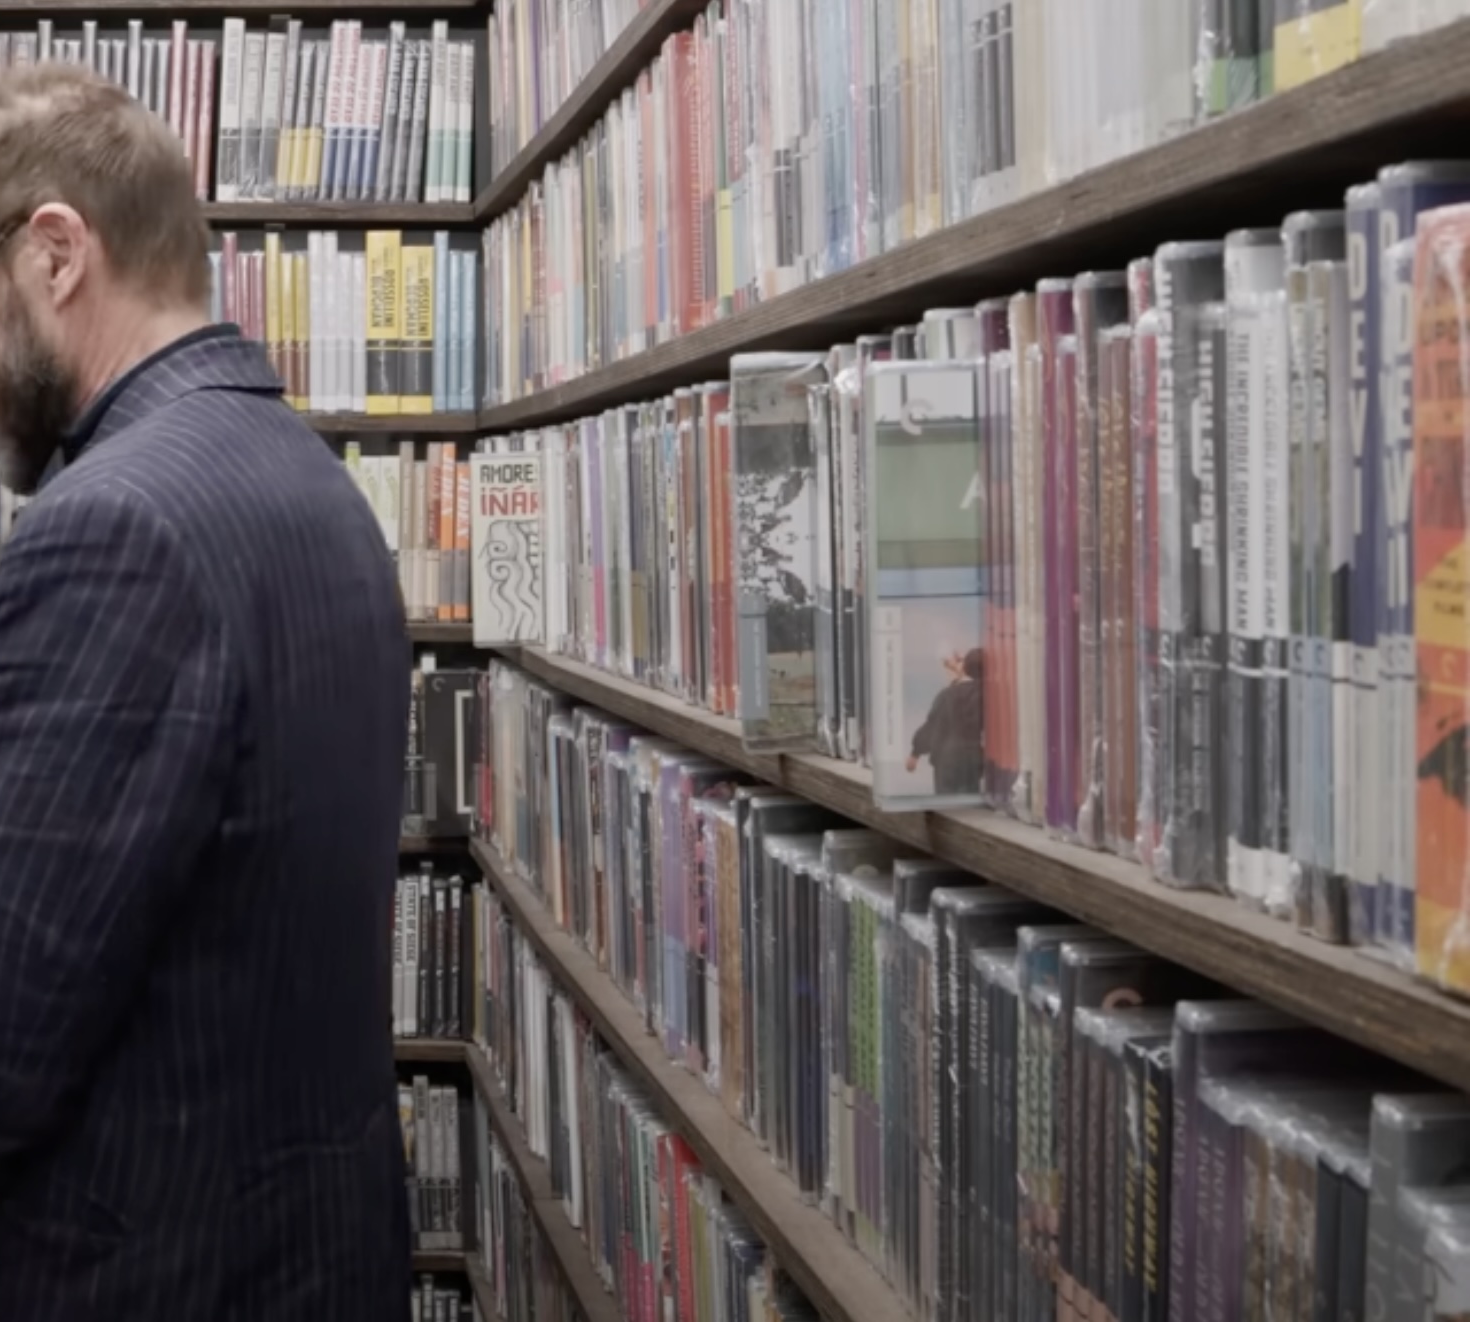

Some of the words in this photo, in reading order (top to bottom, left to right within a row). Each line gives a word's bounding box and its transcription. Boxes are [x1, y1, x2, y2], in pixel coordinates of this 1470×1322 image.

[1197, 340, 1215, 428] HIGH
[1235, 332, 1249, 363] THE
[1349, 232, 1367, 535] DEVI
[1235, 370, 1249, 473] INCREDIBLE
[1394, 281, 1412, 606] DEVI
[480, 464, 538, 483] AMORE
[1197, 438, 1215, 567] SIERRA
[1235, 480, 1249, 582] SHRINKING
[1264, 477, 1276, 581] SHRINKING
[1235, 589, 1249, 630] MAN
[1264, 587, 1275, 628] MAN
